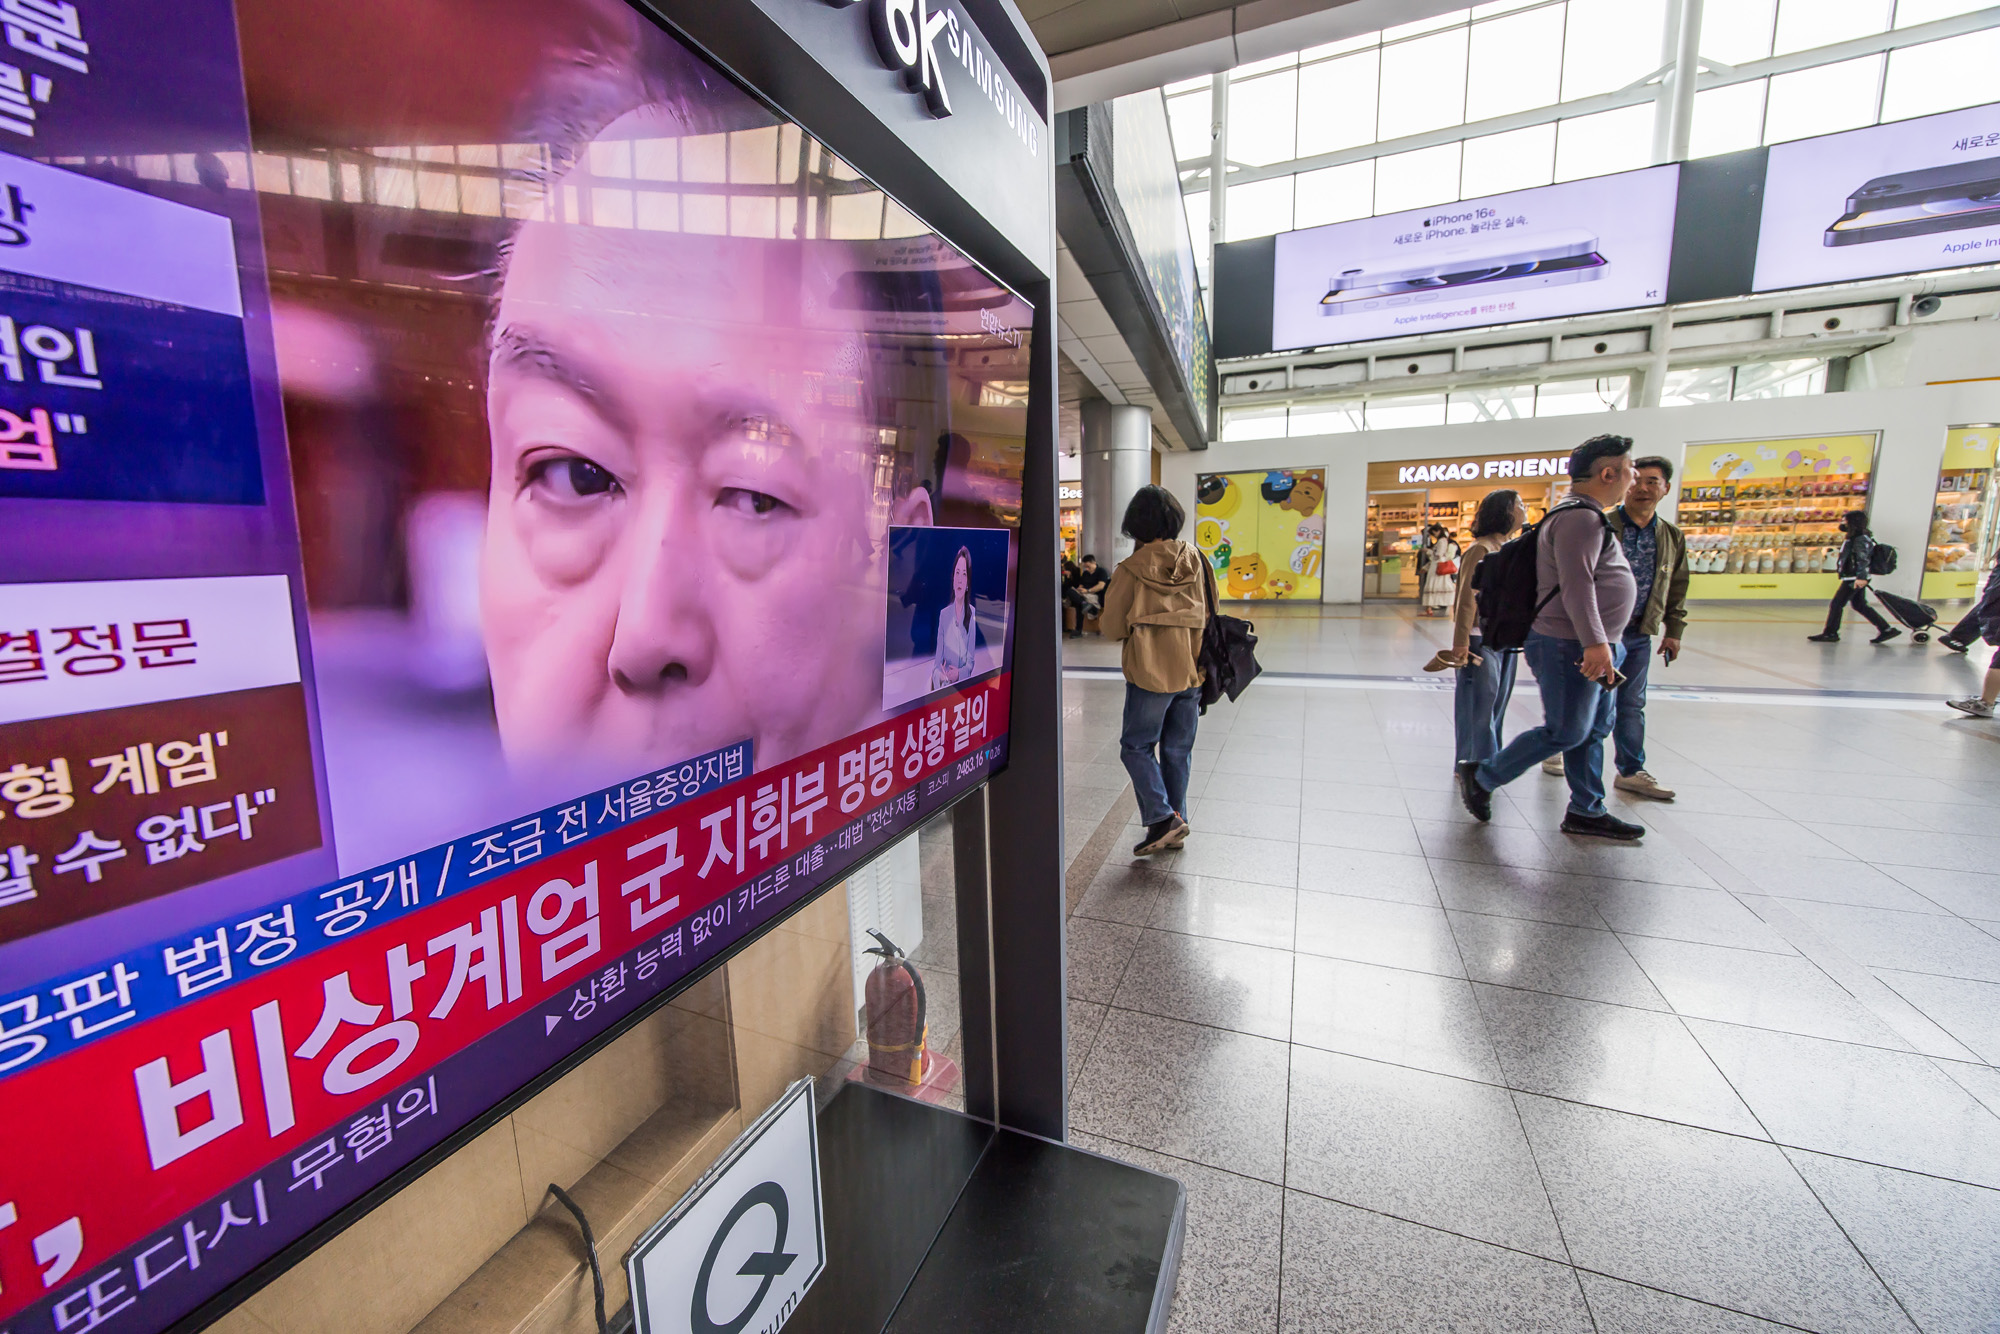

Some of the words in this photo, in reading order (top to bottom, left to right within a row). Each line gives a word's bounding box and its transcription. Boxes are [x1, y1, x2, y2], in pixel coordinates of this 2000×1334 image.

[947, 8, 1039, 158] SAMSUNG
[1952, 132, 2000, 151] 새로운
[1393, 231, 1423, 245] 새로운
[1425, 228, 1468, 241] iPhone.
[1470, 218, 1502, 234] 놀라운
[1432, 211, 1473, 227] iPhone
[1475, 208, 1496, 219] 16e
[1942, 240, 1982, 254] Apple
[1646, 289, 1657, 298] kt
[980, 308, 1023, 350] 연합뉴스TV
[1394, 315, 1418, 325] Apple
[1398, 462, 1480, 484] KAKAO
[89, 730, 228, 794] 계엄'
[926, 770, 950, 797] 코스피
[956, 750, 984, 781] 2483.16
[53, 830, 127, 883] 수
[136, 788, 276, 865] 없다"
[163, 903, 298, 998] 법정
[315, 860, 419, 938] 공개
[435, 845, 455, 897] /
[468, 817, 546, 879] 조금
[556, 800, 589, 842] 전
[597, 745, 745, 826] 서울중앙지법
[567, 962, 628, 1022] 상환
[634, 926, 683, 982] 능력
[691, 899, 732, 940] 없이
[737, 864, 790, 914] 카드론
[895, 788, 919, 816] 자동
[133, 859, 601, 1172] 비상계엄
[621, 826, 686, 932] 군
[697, 762, 829, 881] 지휘부
[837, 730, 896, 814] 명령
[900, 708, 949, 779] 상황
[951, 690, 989, 752] 질의
[52, 1178, 270, 1334] 또다시
[287, 1075, 438, 1192] 무혐의
